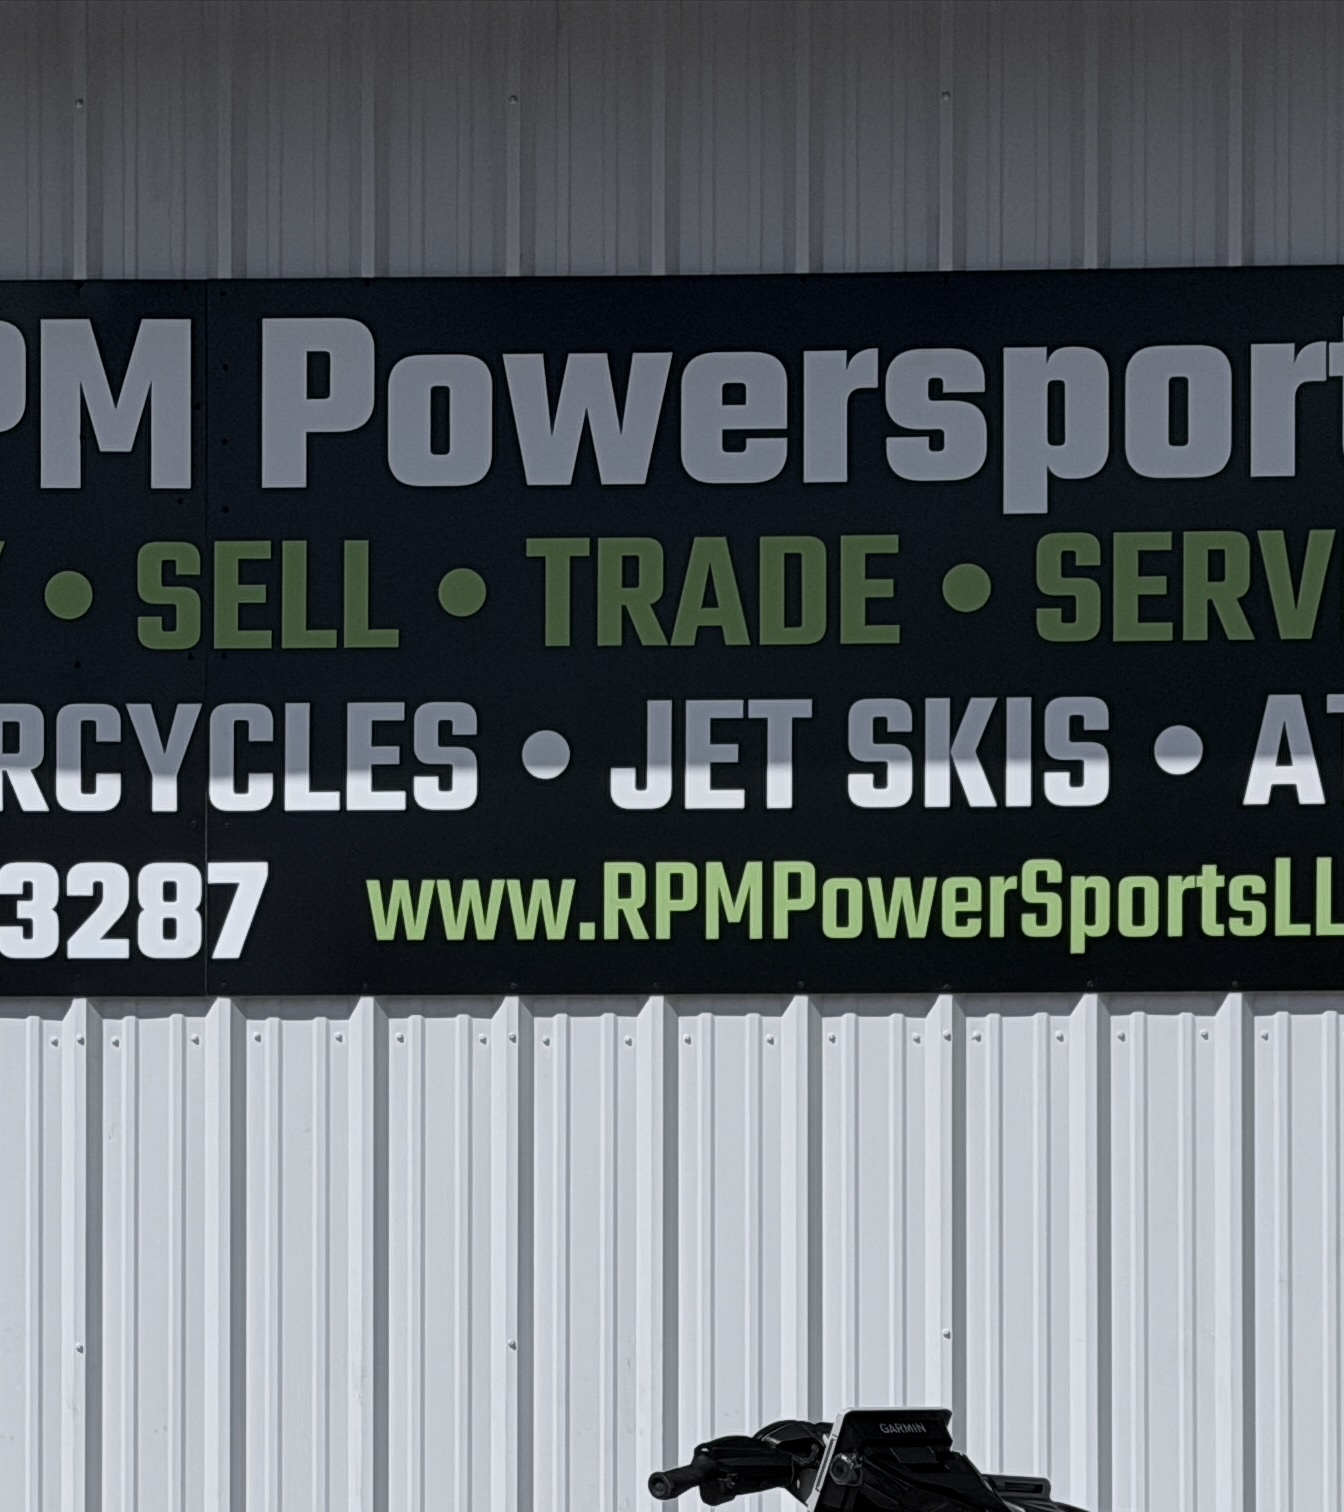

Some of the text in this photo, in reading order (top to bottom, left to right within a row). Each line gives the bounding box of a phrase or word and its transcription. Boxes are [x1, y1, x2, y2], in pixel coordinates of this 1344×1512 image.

[136, 539, 400, 651] SELL
[525, 534, 902, 648] TRADE
[610, 697, 813, 811] JET
[847, 695, 1111, 809] SKIS
[879, 1422, 927, 1434] GARMIN
